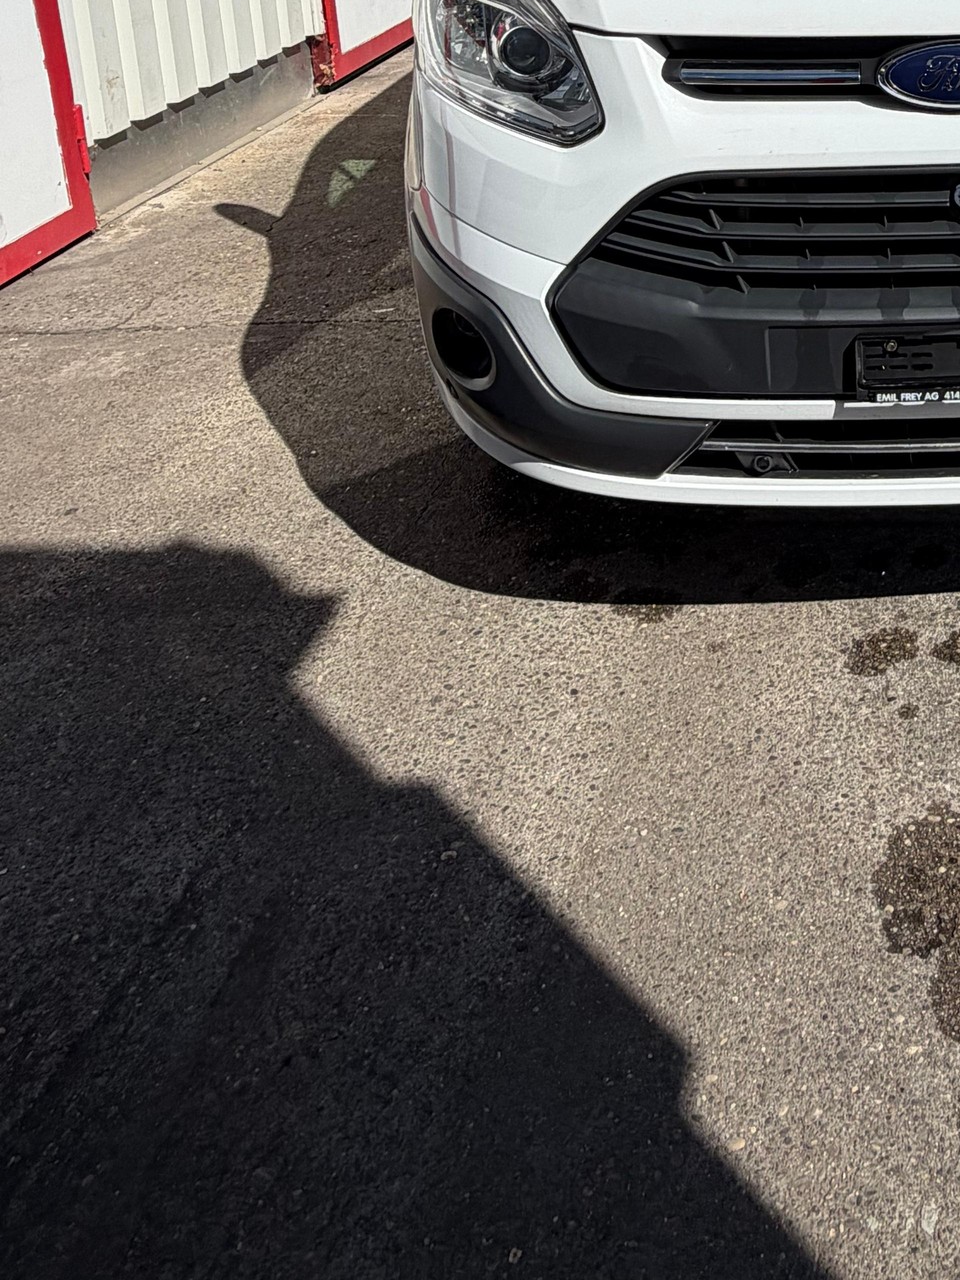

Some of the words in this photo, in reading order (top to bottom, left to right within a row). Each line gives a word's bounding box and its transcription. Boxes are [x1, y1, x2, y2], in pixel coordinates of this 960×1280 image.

[876, 393, 898, 402] EMIL
[901, 392, 922, 401] FREY
[924, 392, 939, 400] AG
